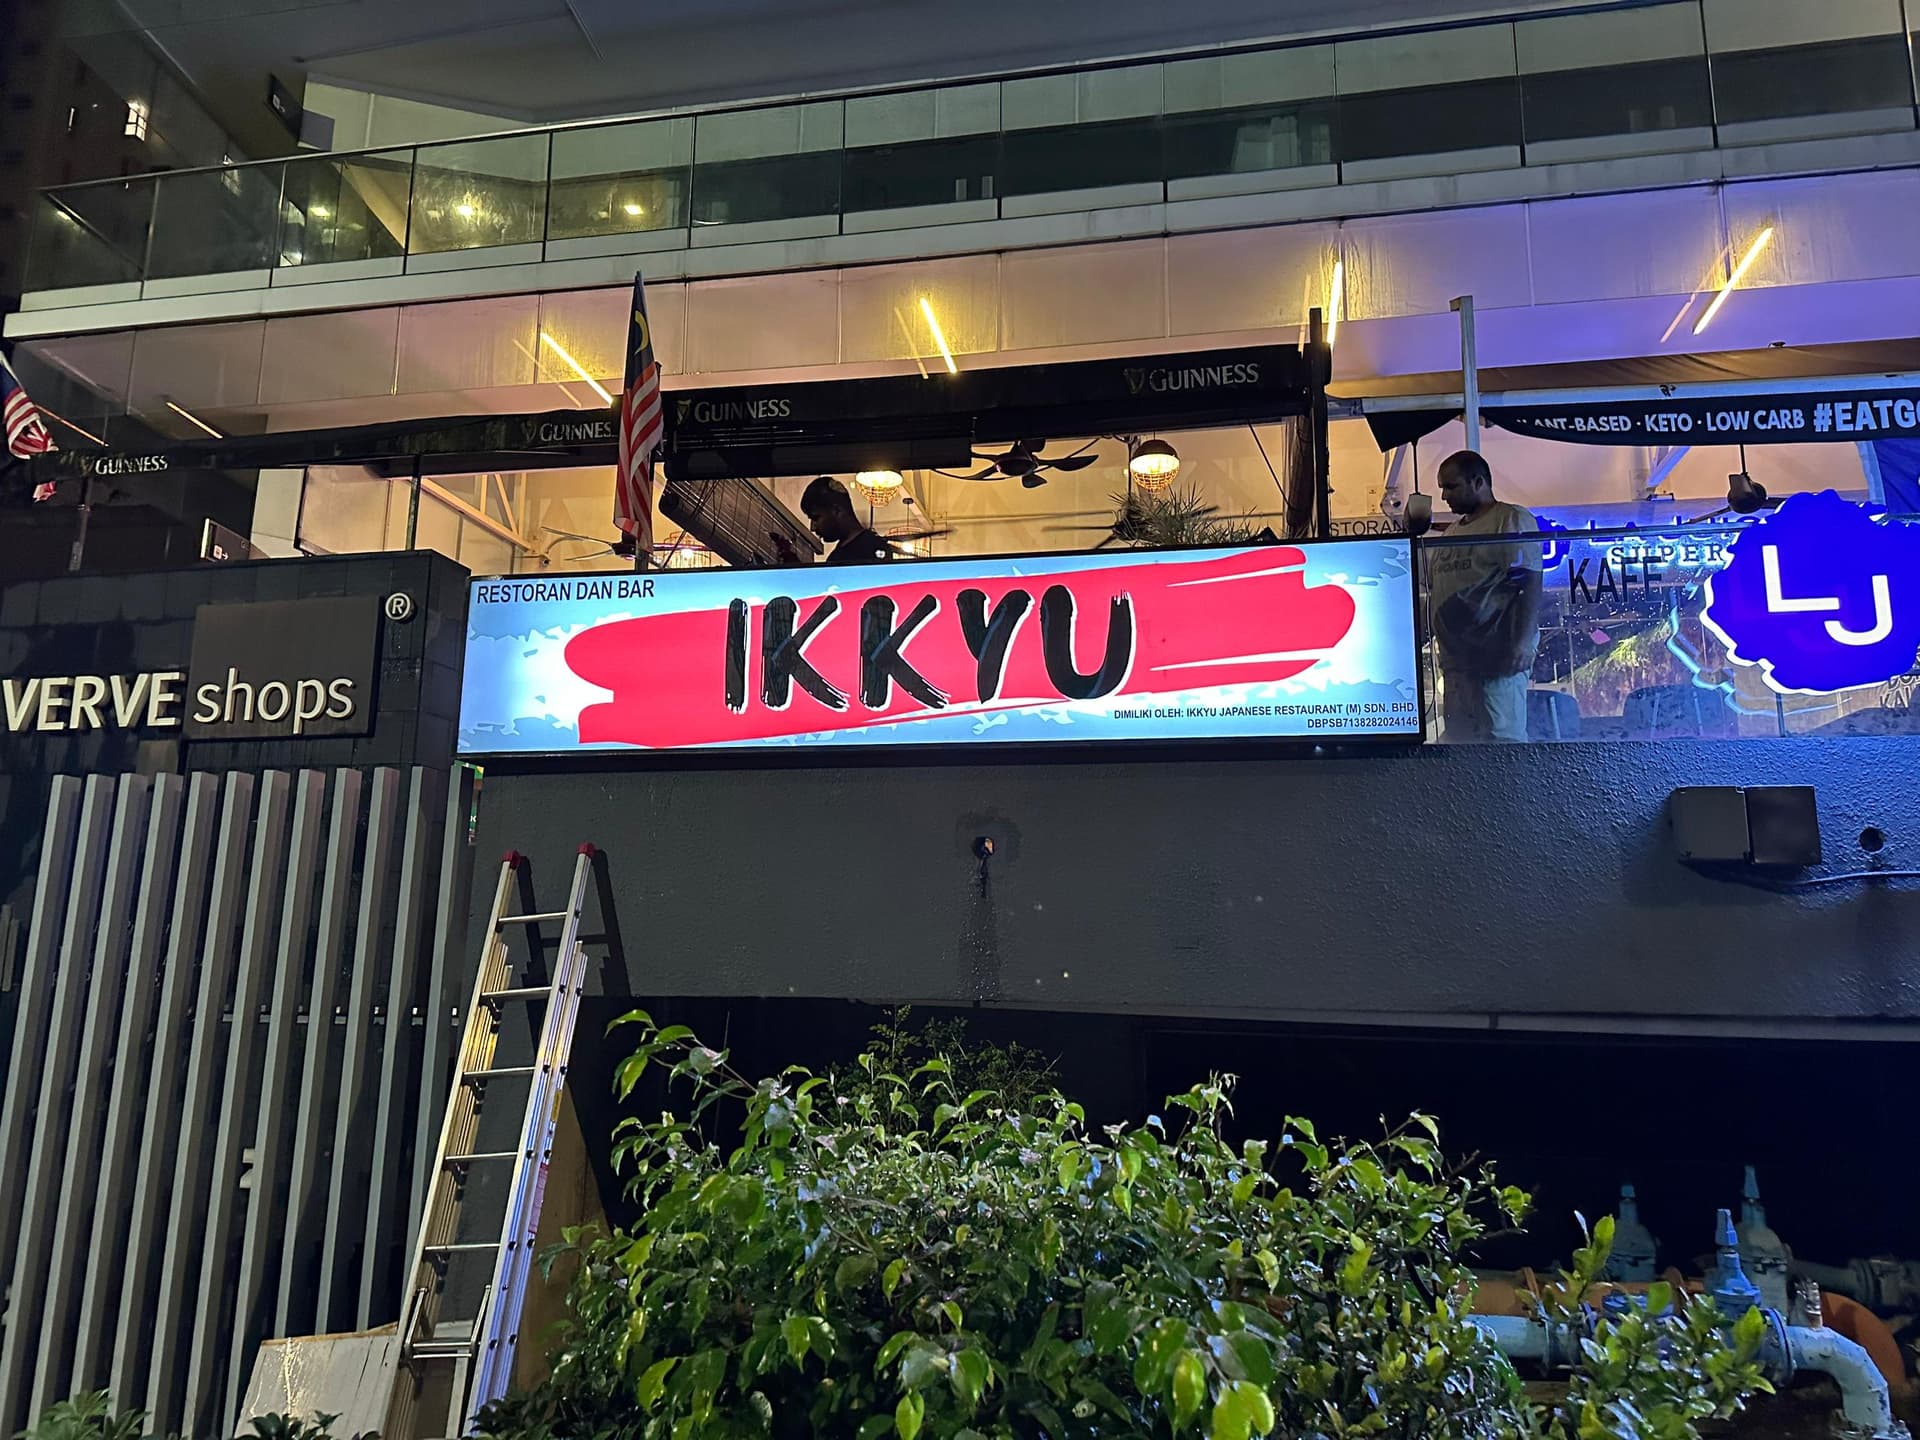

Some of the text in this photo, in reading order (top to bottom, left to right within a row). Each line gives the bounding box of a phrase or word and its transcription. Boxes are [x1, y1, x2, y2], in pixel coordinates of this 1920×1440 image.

[1150, 363, 1259, 391] GUINNESS
[694, 399, 791, 423] GUINNESS
[1644, 412, 1693, 432] KETO
[1706, 411, 1750, 431] LOW
[1753, 409, 1805, 430] CARB
[1813, 398, 1920, 432] #EATG
[95, 456, 168, 475] GUINNESS
[477, 579, 655, 604] RESTORAN DAN BAR
[1568, 556, 1662, 604] KAFE
[724, 584, 1138, 714] IKKYU
[2, 667, 355, 735] VERVE shops
[1114, 702, 1417, 720] DIMILIKI OLEH: IKKYU JAPANESE RESTAURANT (M) SDN. BHD.
[1307, 716, 1418, 729] DBPSB7138282024146
